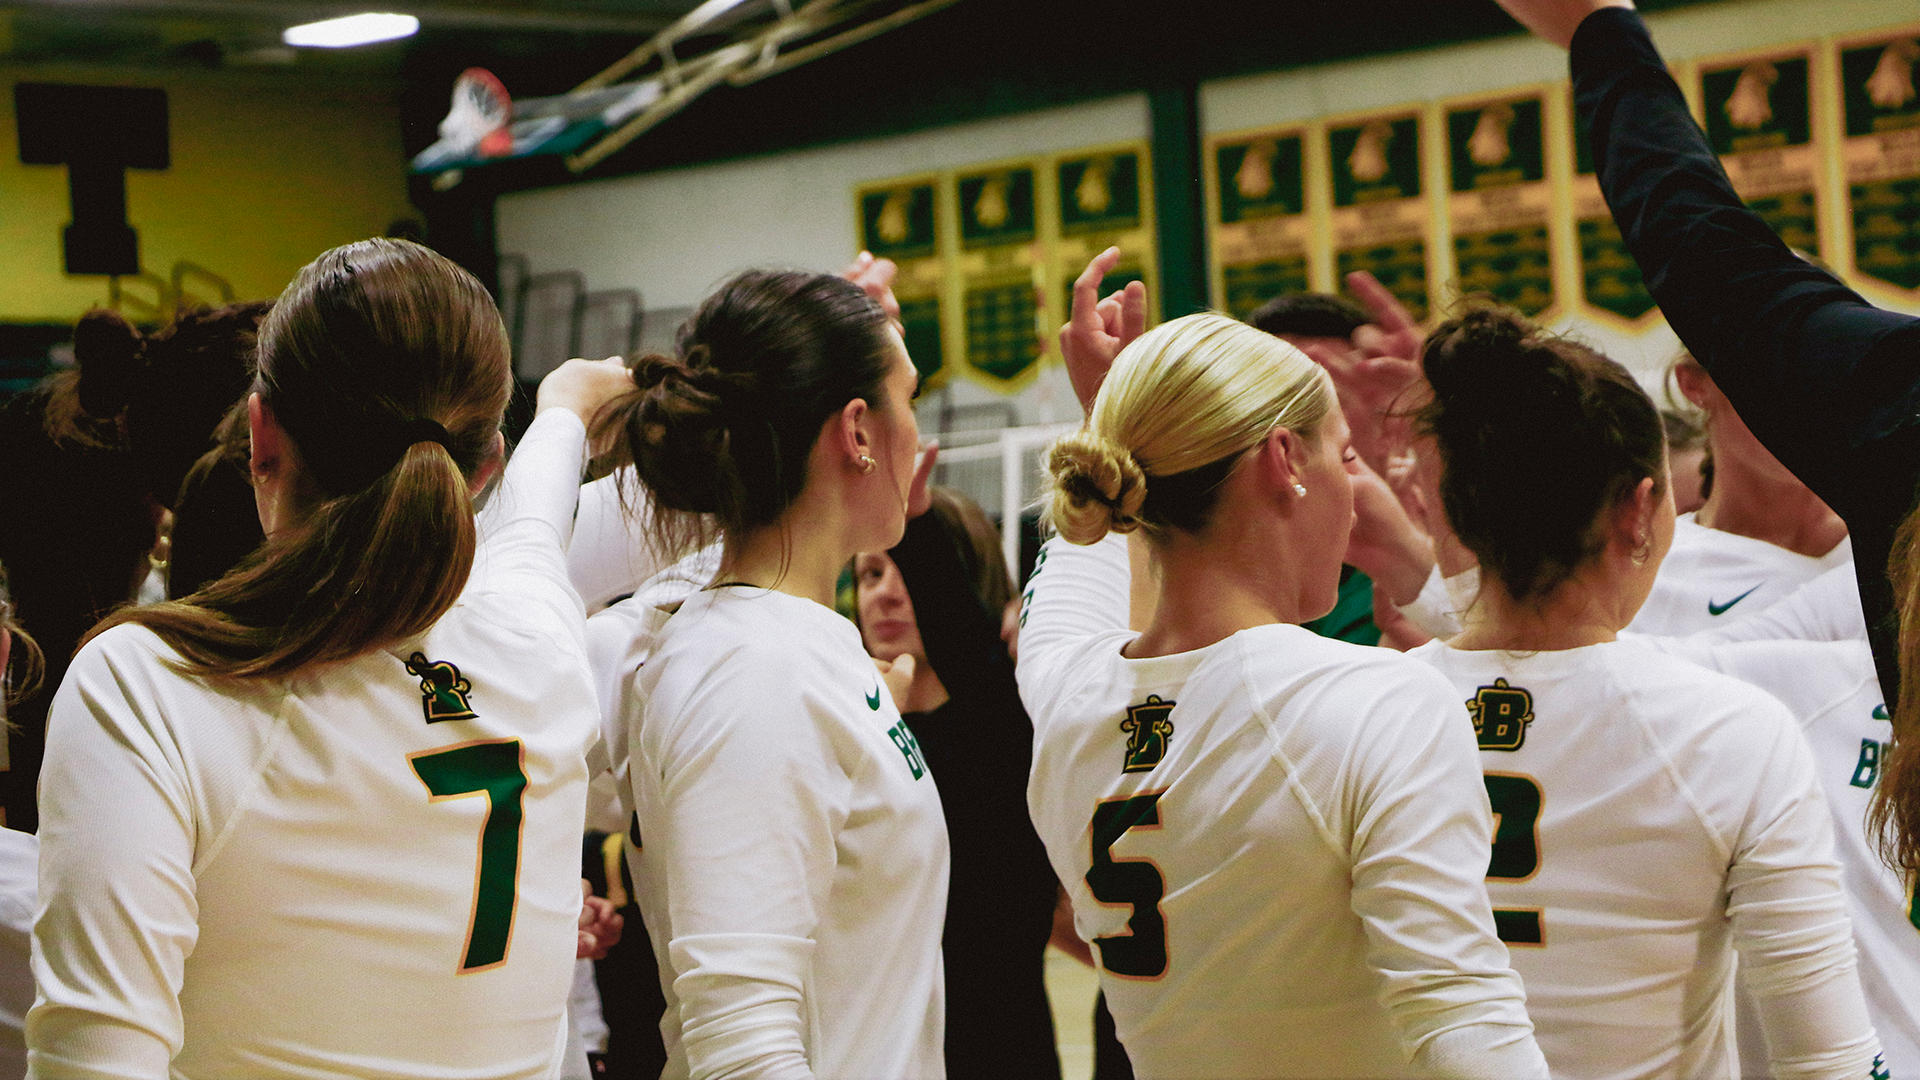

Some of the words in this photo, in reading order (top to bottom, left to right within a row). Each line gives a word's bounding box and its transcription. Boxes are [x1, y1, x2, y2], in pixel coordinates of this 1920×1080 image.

[15, 83, 170, 275] T
[405, 737, 531, 976] 7
[1084, 785, 1171, 982] 5
